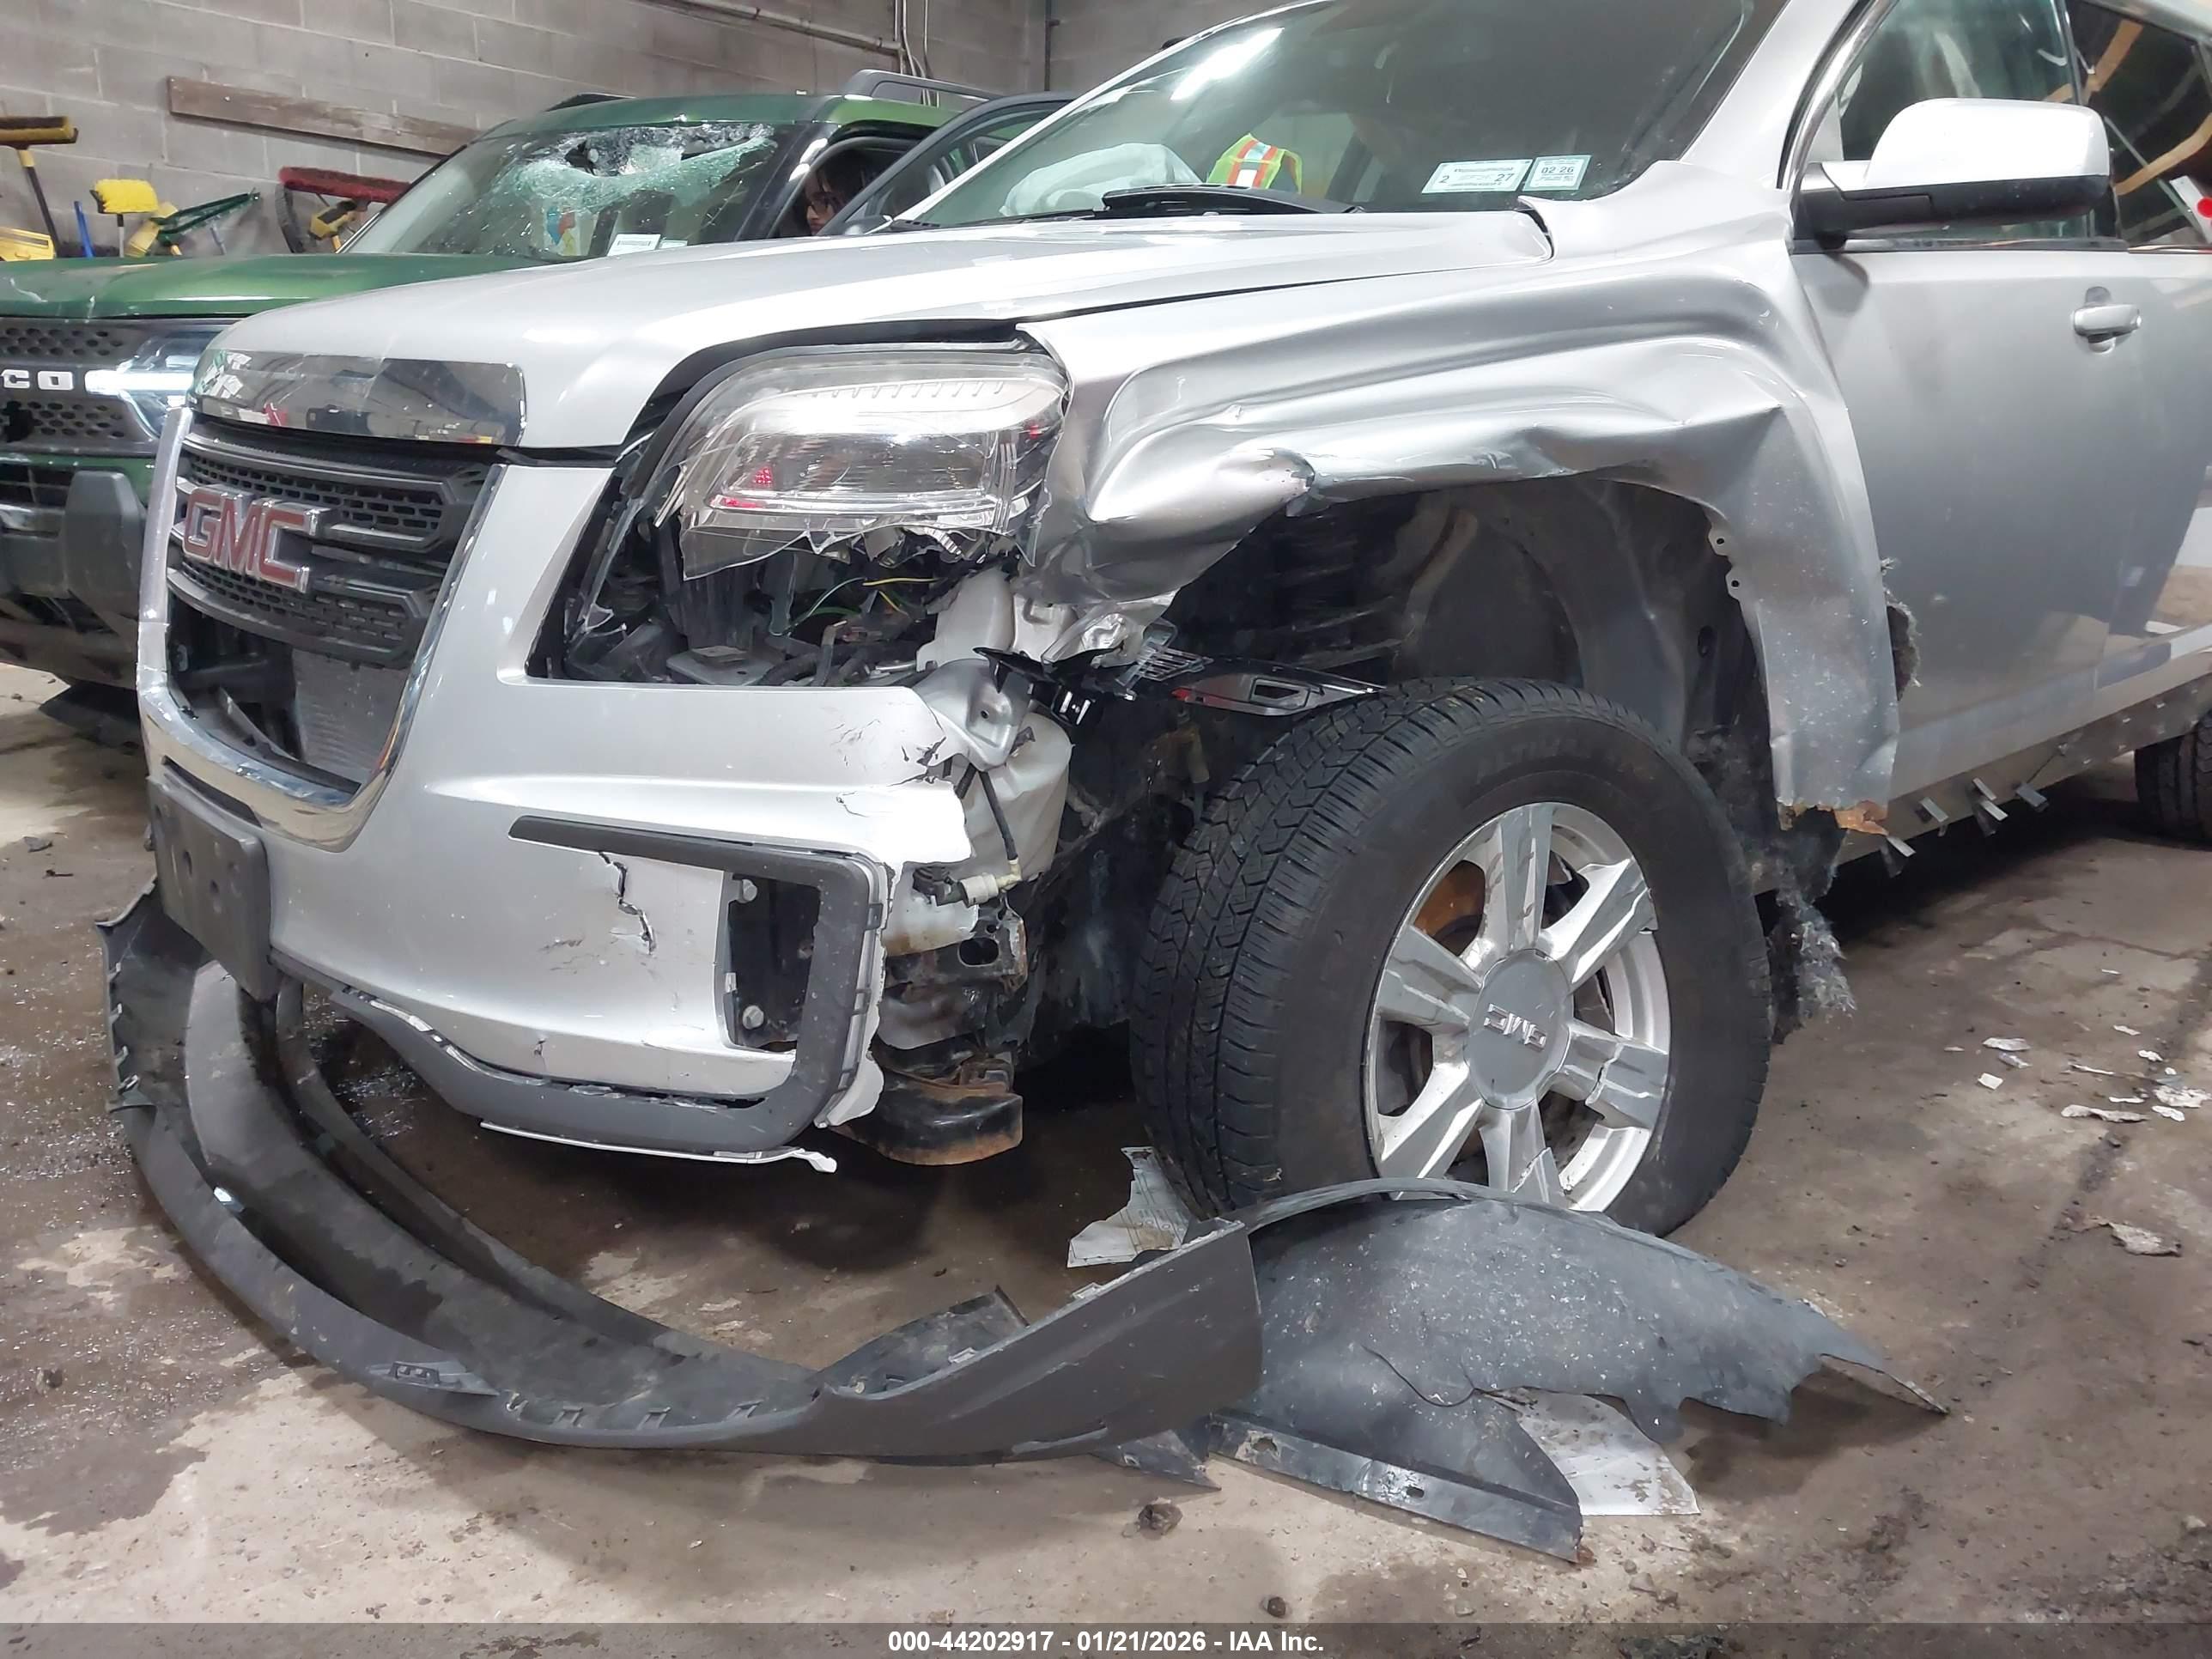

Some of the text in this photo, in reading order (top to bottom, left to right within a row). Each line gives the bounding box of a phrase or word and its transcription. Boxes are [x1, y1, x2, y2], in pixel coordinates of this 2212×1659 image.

[1494, 173, 1515, 182] 27
[182, 484, 319, 593] GMC
[1484, 1003, 1547, 1050] GMC
